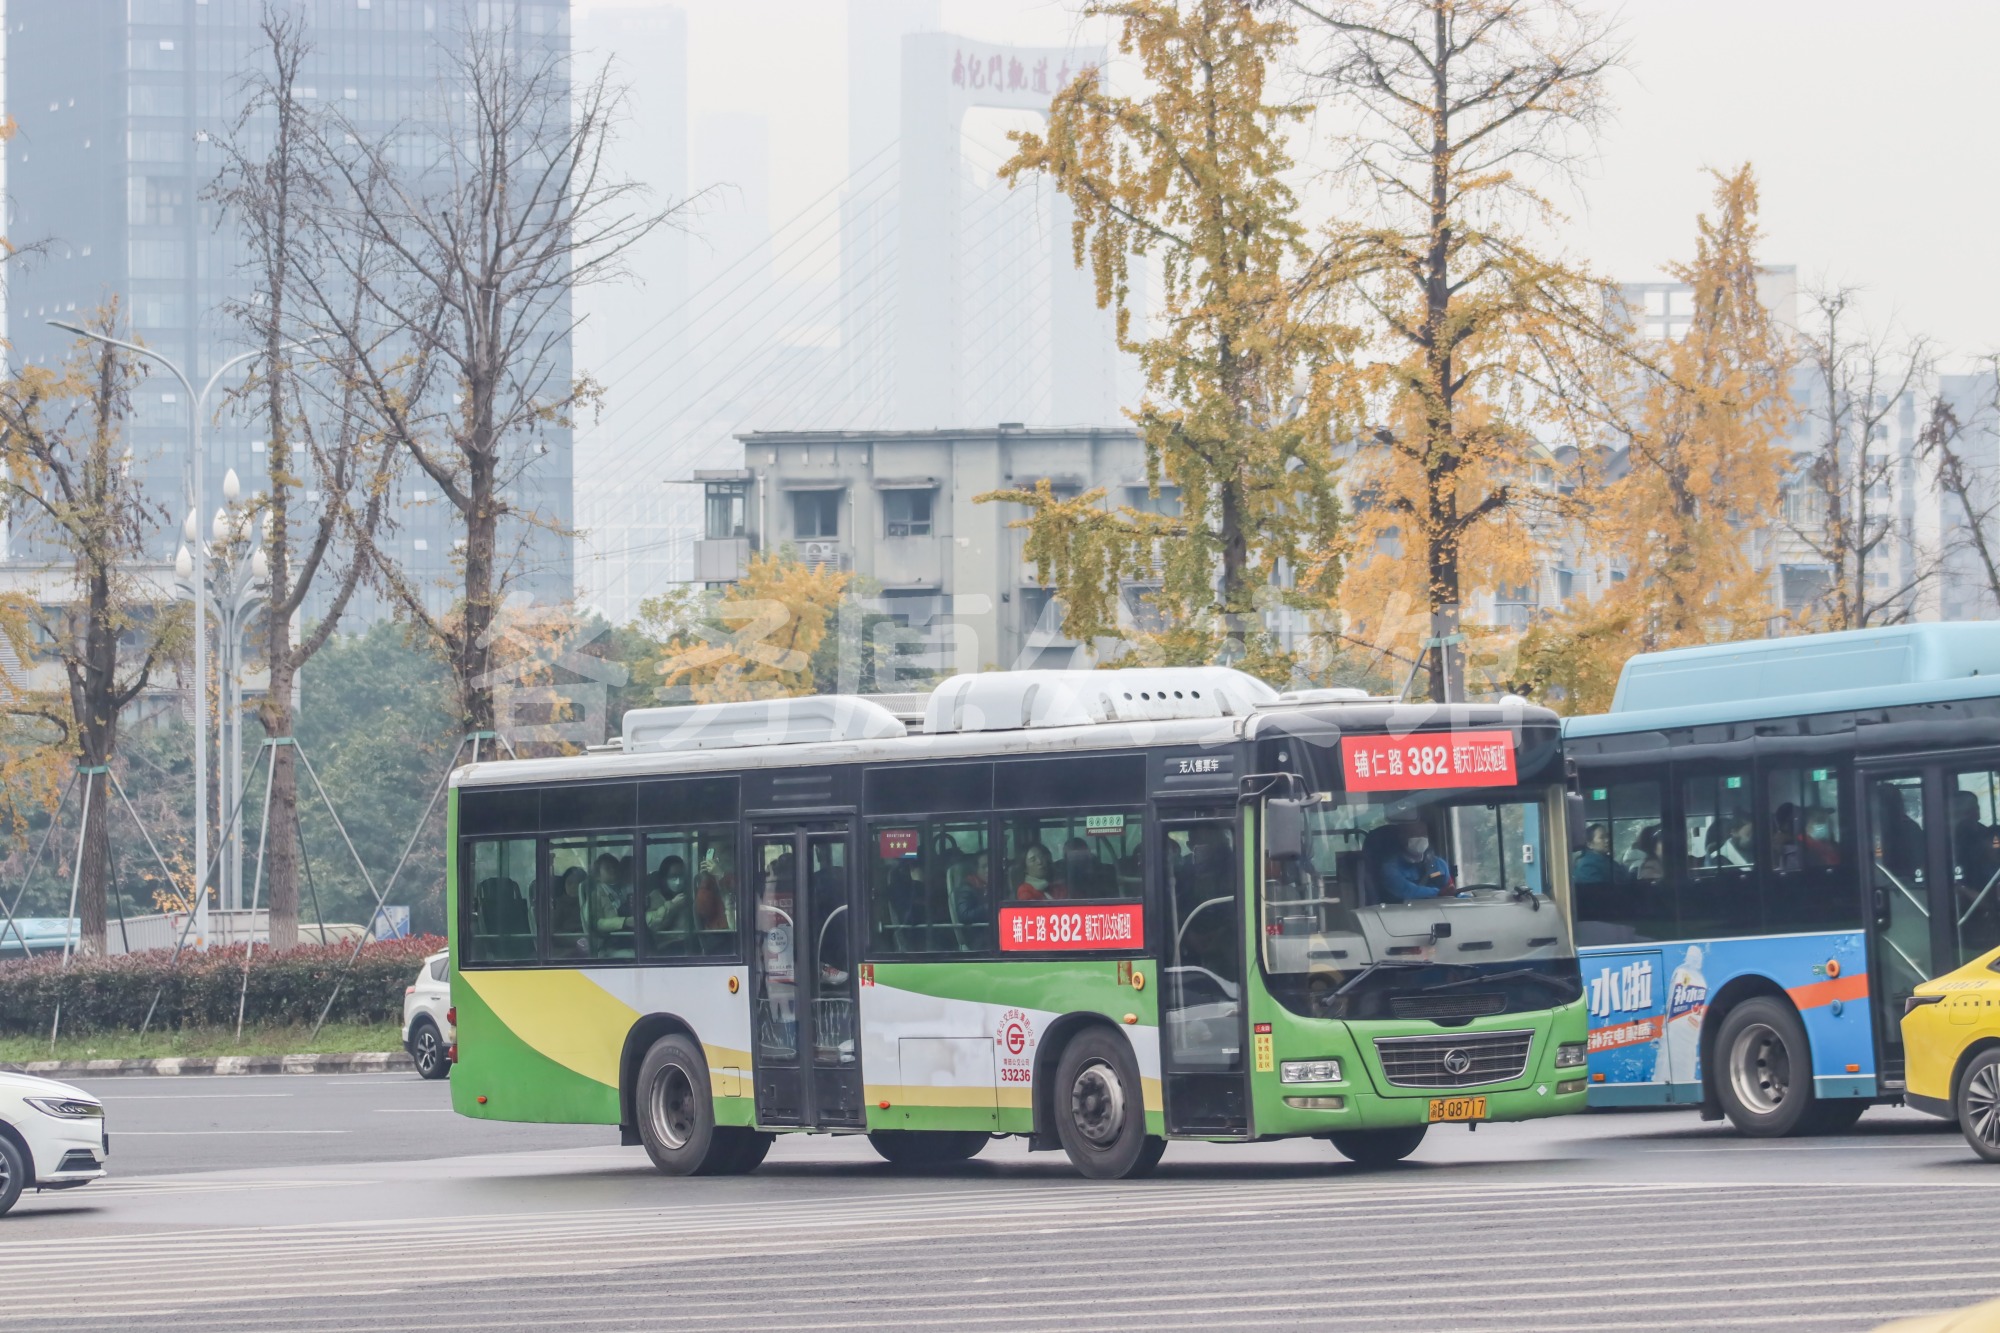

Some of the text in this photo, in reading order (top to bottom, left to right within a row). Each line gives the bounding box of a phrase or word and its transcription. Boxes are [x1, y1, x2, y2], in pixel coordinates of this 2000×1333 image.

[1179, 759, 1219, 774] 无人售票车
[1353, 746, 1508, 778] 辅仁路 382 朝天门公交枢纽
[1012, 912, 1132, 943] 辅仁路 382 朝天门公交枢纽
[1584, 960, 1652, 1017] 水啦
[1001, 1068, 1031, 1082] 33236
